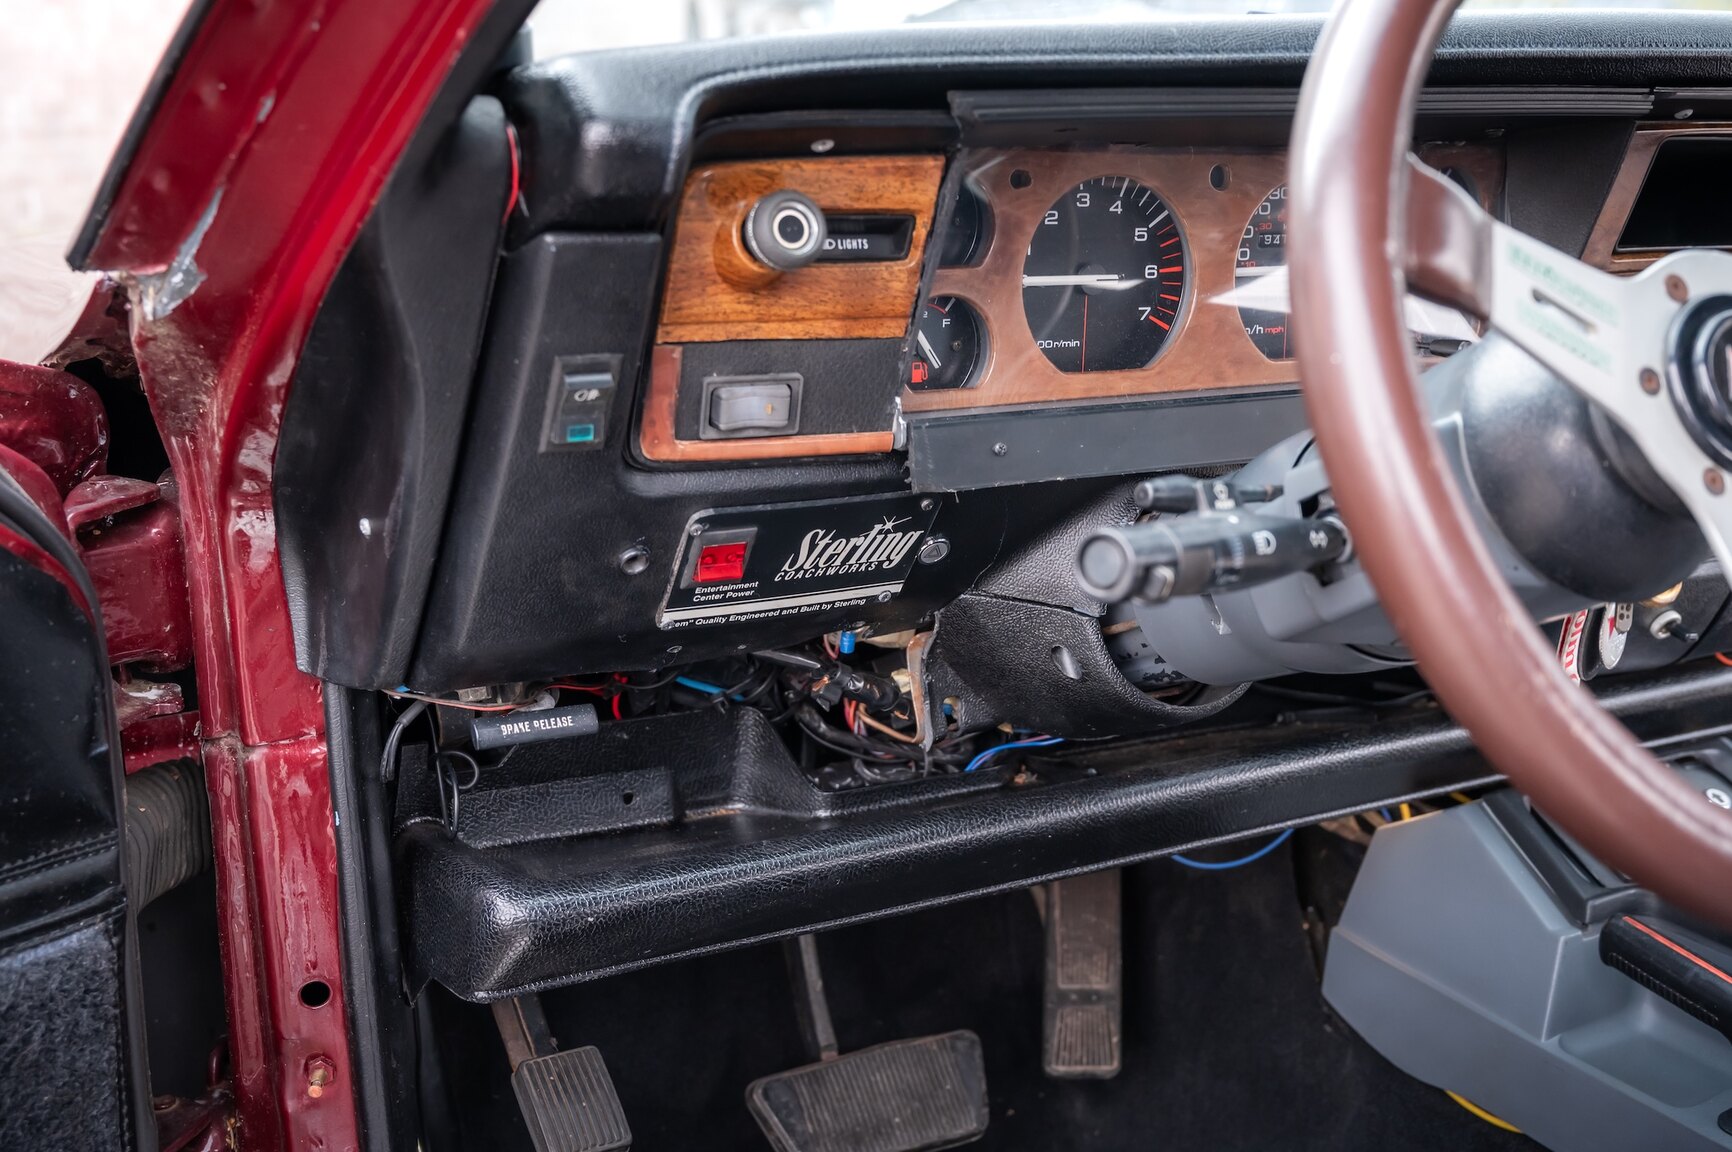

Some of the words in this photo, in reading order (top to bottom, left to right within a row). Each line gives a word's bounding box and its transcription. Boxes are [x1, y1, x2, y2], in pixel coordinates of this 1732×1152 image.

[1076, 193, 1090, 207] 3
[1109, 200, 1123, 215] 4
[1044, 210, 1059, 225] 2
[1134, 228, 1148, 242] 5
[837, 238, 869, 250] LIGHTS
[1144, 265, 1158, 279] 6
[1138, 306, 1151, 321] 7
[942, 318, 951, 328] F
[1264, 326, 1284, 335] mph
[781, 518, 924, 569] Sterling
[774, 561, 878, 583] COACHWORKS
[695, 581, 759, 594] Entertainment
[693, 593, 724, 602] Center
[725, 591, 755, 599] Power
[695, 617, 727, 625] Quality
[729, 609, 780, 621] Engineered
[781, 607, 798, 616] and
[799, 604, 820, 613] Built
[821, 602, 833, 611] by
[833, 598, 867, 608] Sterling
[501, 721, 530, 735] BRAKE
[533, 716, 574, 730] RELEASE
